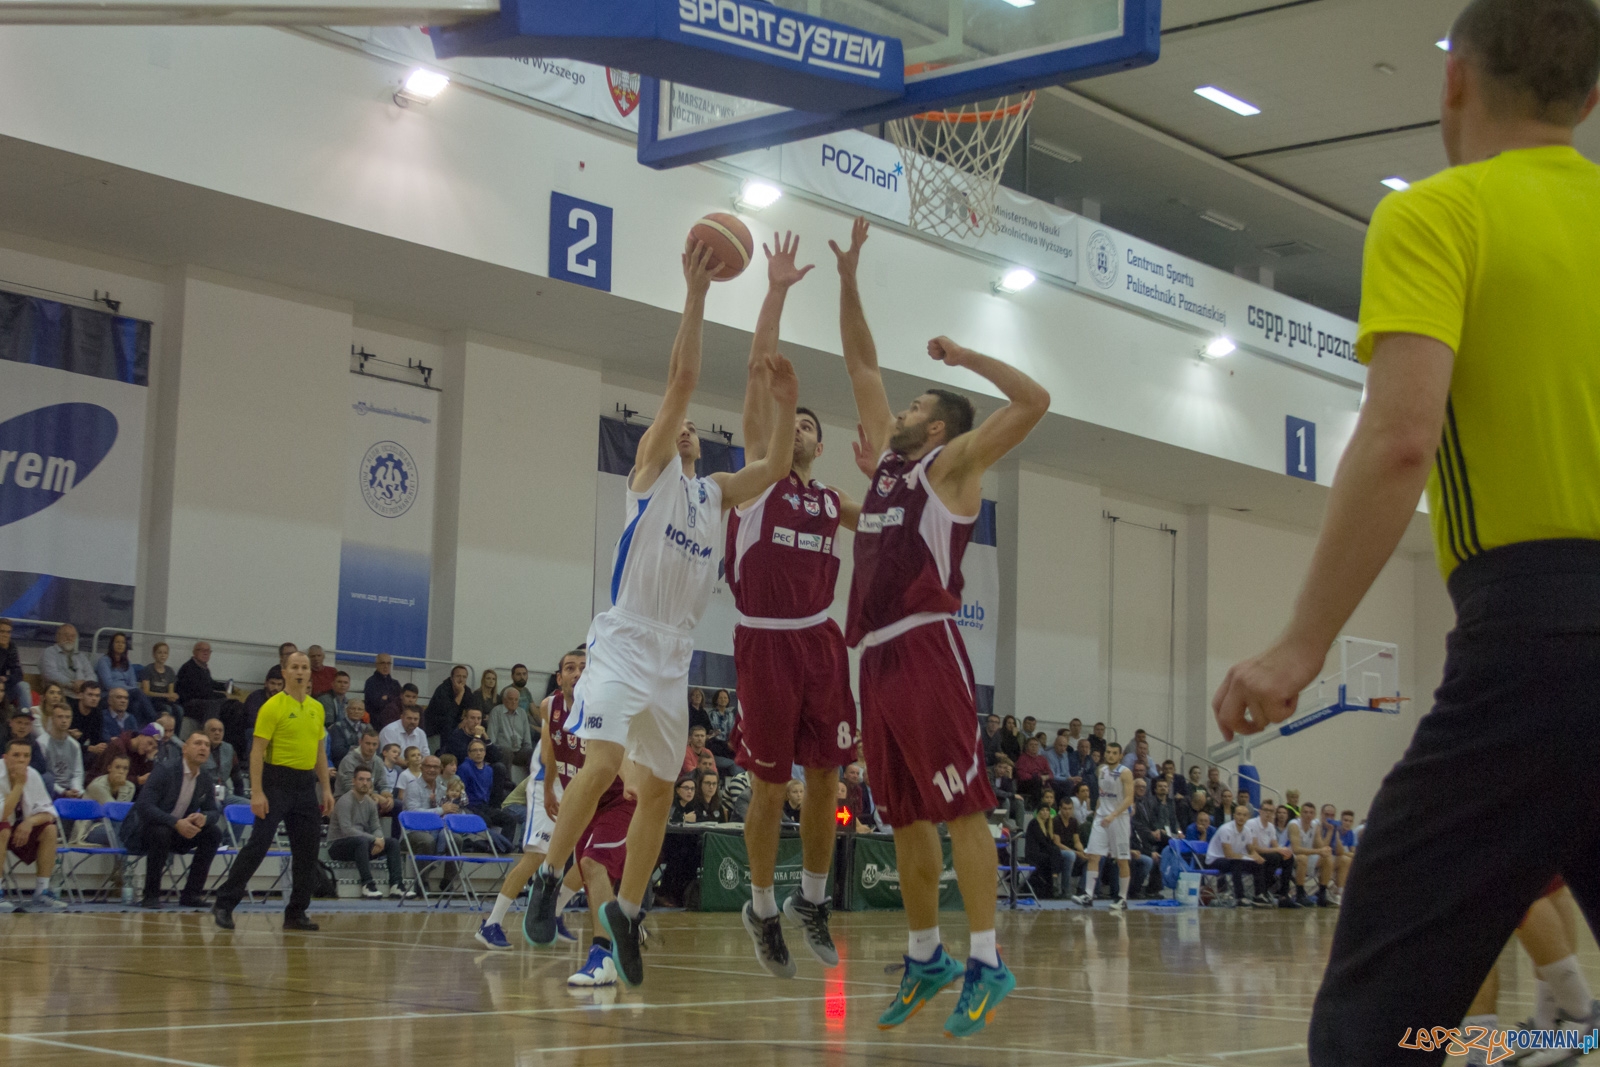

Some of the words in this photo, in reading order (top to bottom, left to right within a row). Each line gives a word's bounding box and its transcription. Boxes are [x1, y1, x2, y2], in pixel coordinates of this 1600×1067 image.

[532, 57, 586, 85] Wyższego
[1039, 220, 1060, 237] Nauki
[566, 207, 598, 279] 2
[1126, 248, 1165, 277] Centrum
[1166, 263, 1194, 288] Sportu
[1126, 274, 1177, 307] Politechniki
[1178, 292, 1227, 328] Poznańskiej
[1296, 426, 1308, 473] 1
[823, 493, 838, 519] 8
[773, 532, 792, 544] PEC
[799, 539, 819, 548] MPGK
[951, 600, 985, 621] ub
[956, 619, 984, 631] dróży
[837, 721, 852, 749] 8
[932, 763, 965, 803] 14
